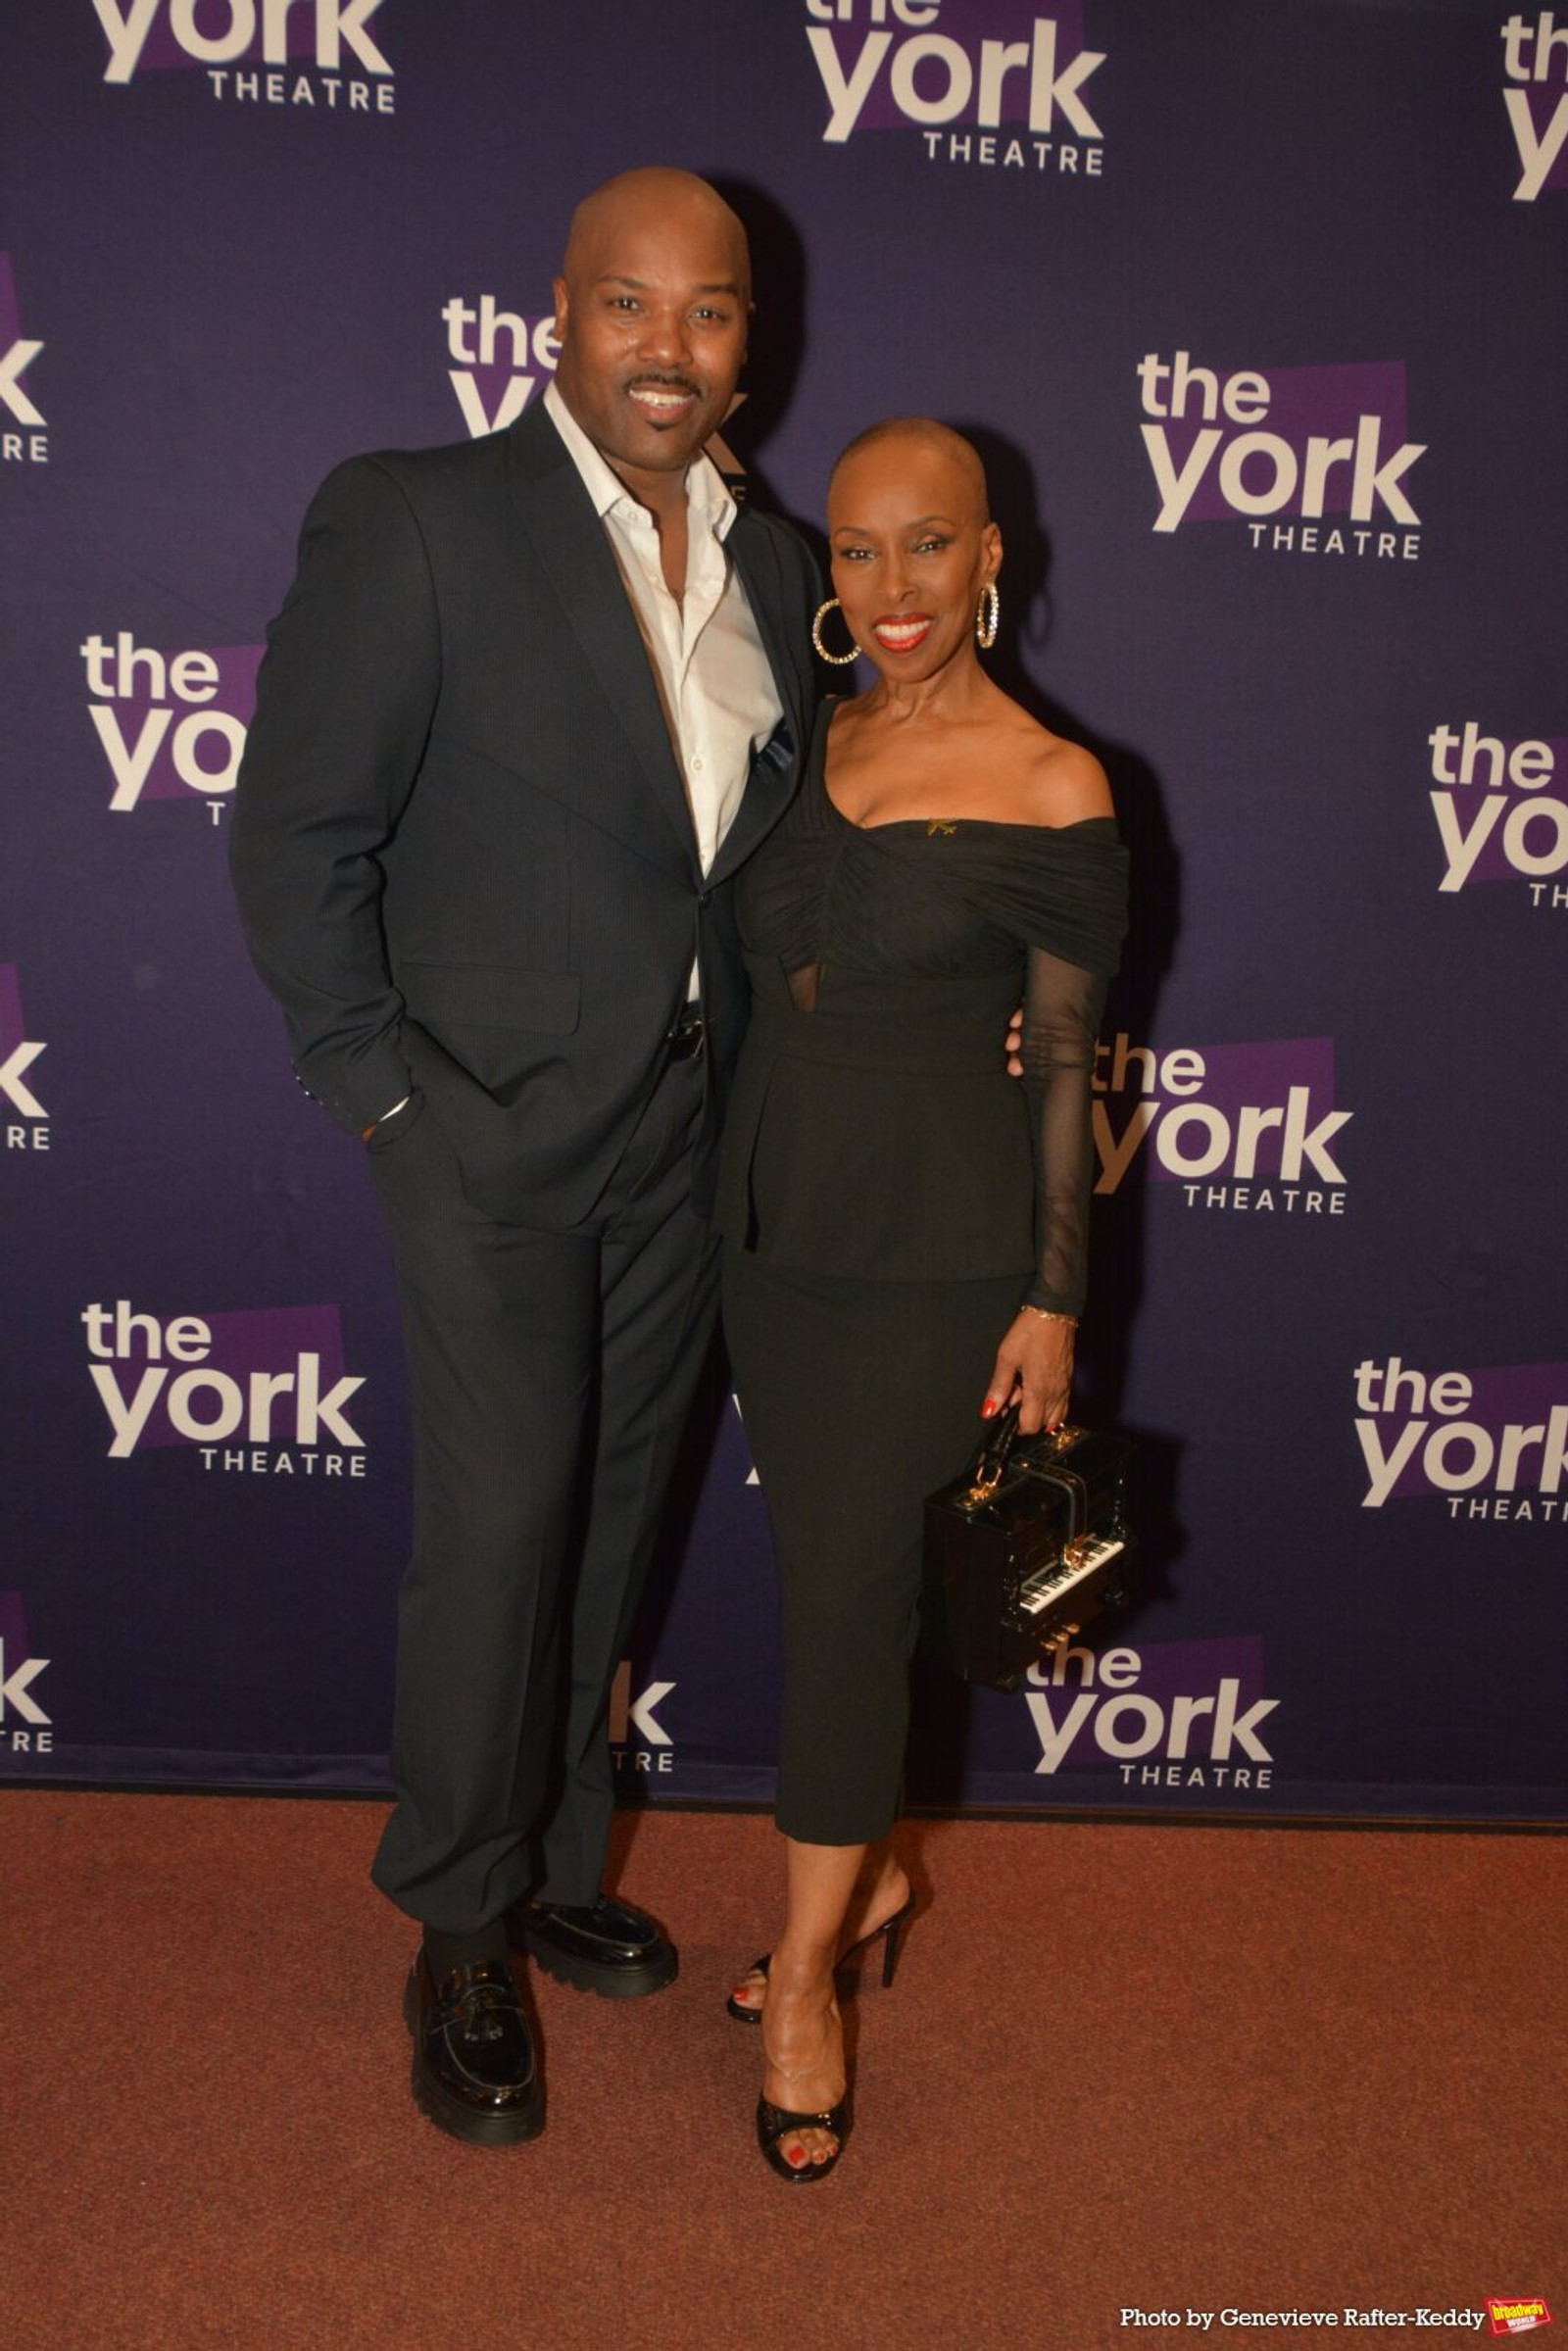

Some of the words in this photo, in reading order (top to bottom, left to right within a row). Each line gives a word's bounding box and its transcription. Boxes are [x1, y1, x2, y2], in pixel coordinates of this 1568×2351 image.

[92, 0, 394, 84] york
[207, 71, 394, 114] THEATRE
[806, 18, 1106, 143] york
[923, 131, 1103, 175] THEATRE
[1136, 351, 1271, 424] the
[1140, 415, 1428, 533] york
[1248, 523, 1420, 560] THEATRE
[79, 631, 220, 704] the
[1428, 721, 1554, 790] the
[1092, 1086, 1353, 1195] york
[1183, 1185, 1346, 1214] THEATRE
[80, 1299, 212, 1362] the
[88, 1351, 367, 1458] york
[1353, 1356, 1473, 1415] the
[199, 1448, 367, 1477] THEATRE
[1024, 1678, 1281, 1774] york
[1119, 1765, 1272, 1788] THEATRE
